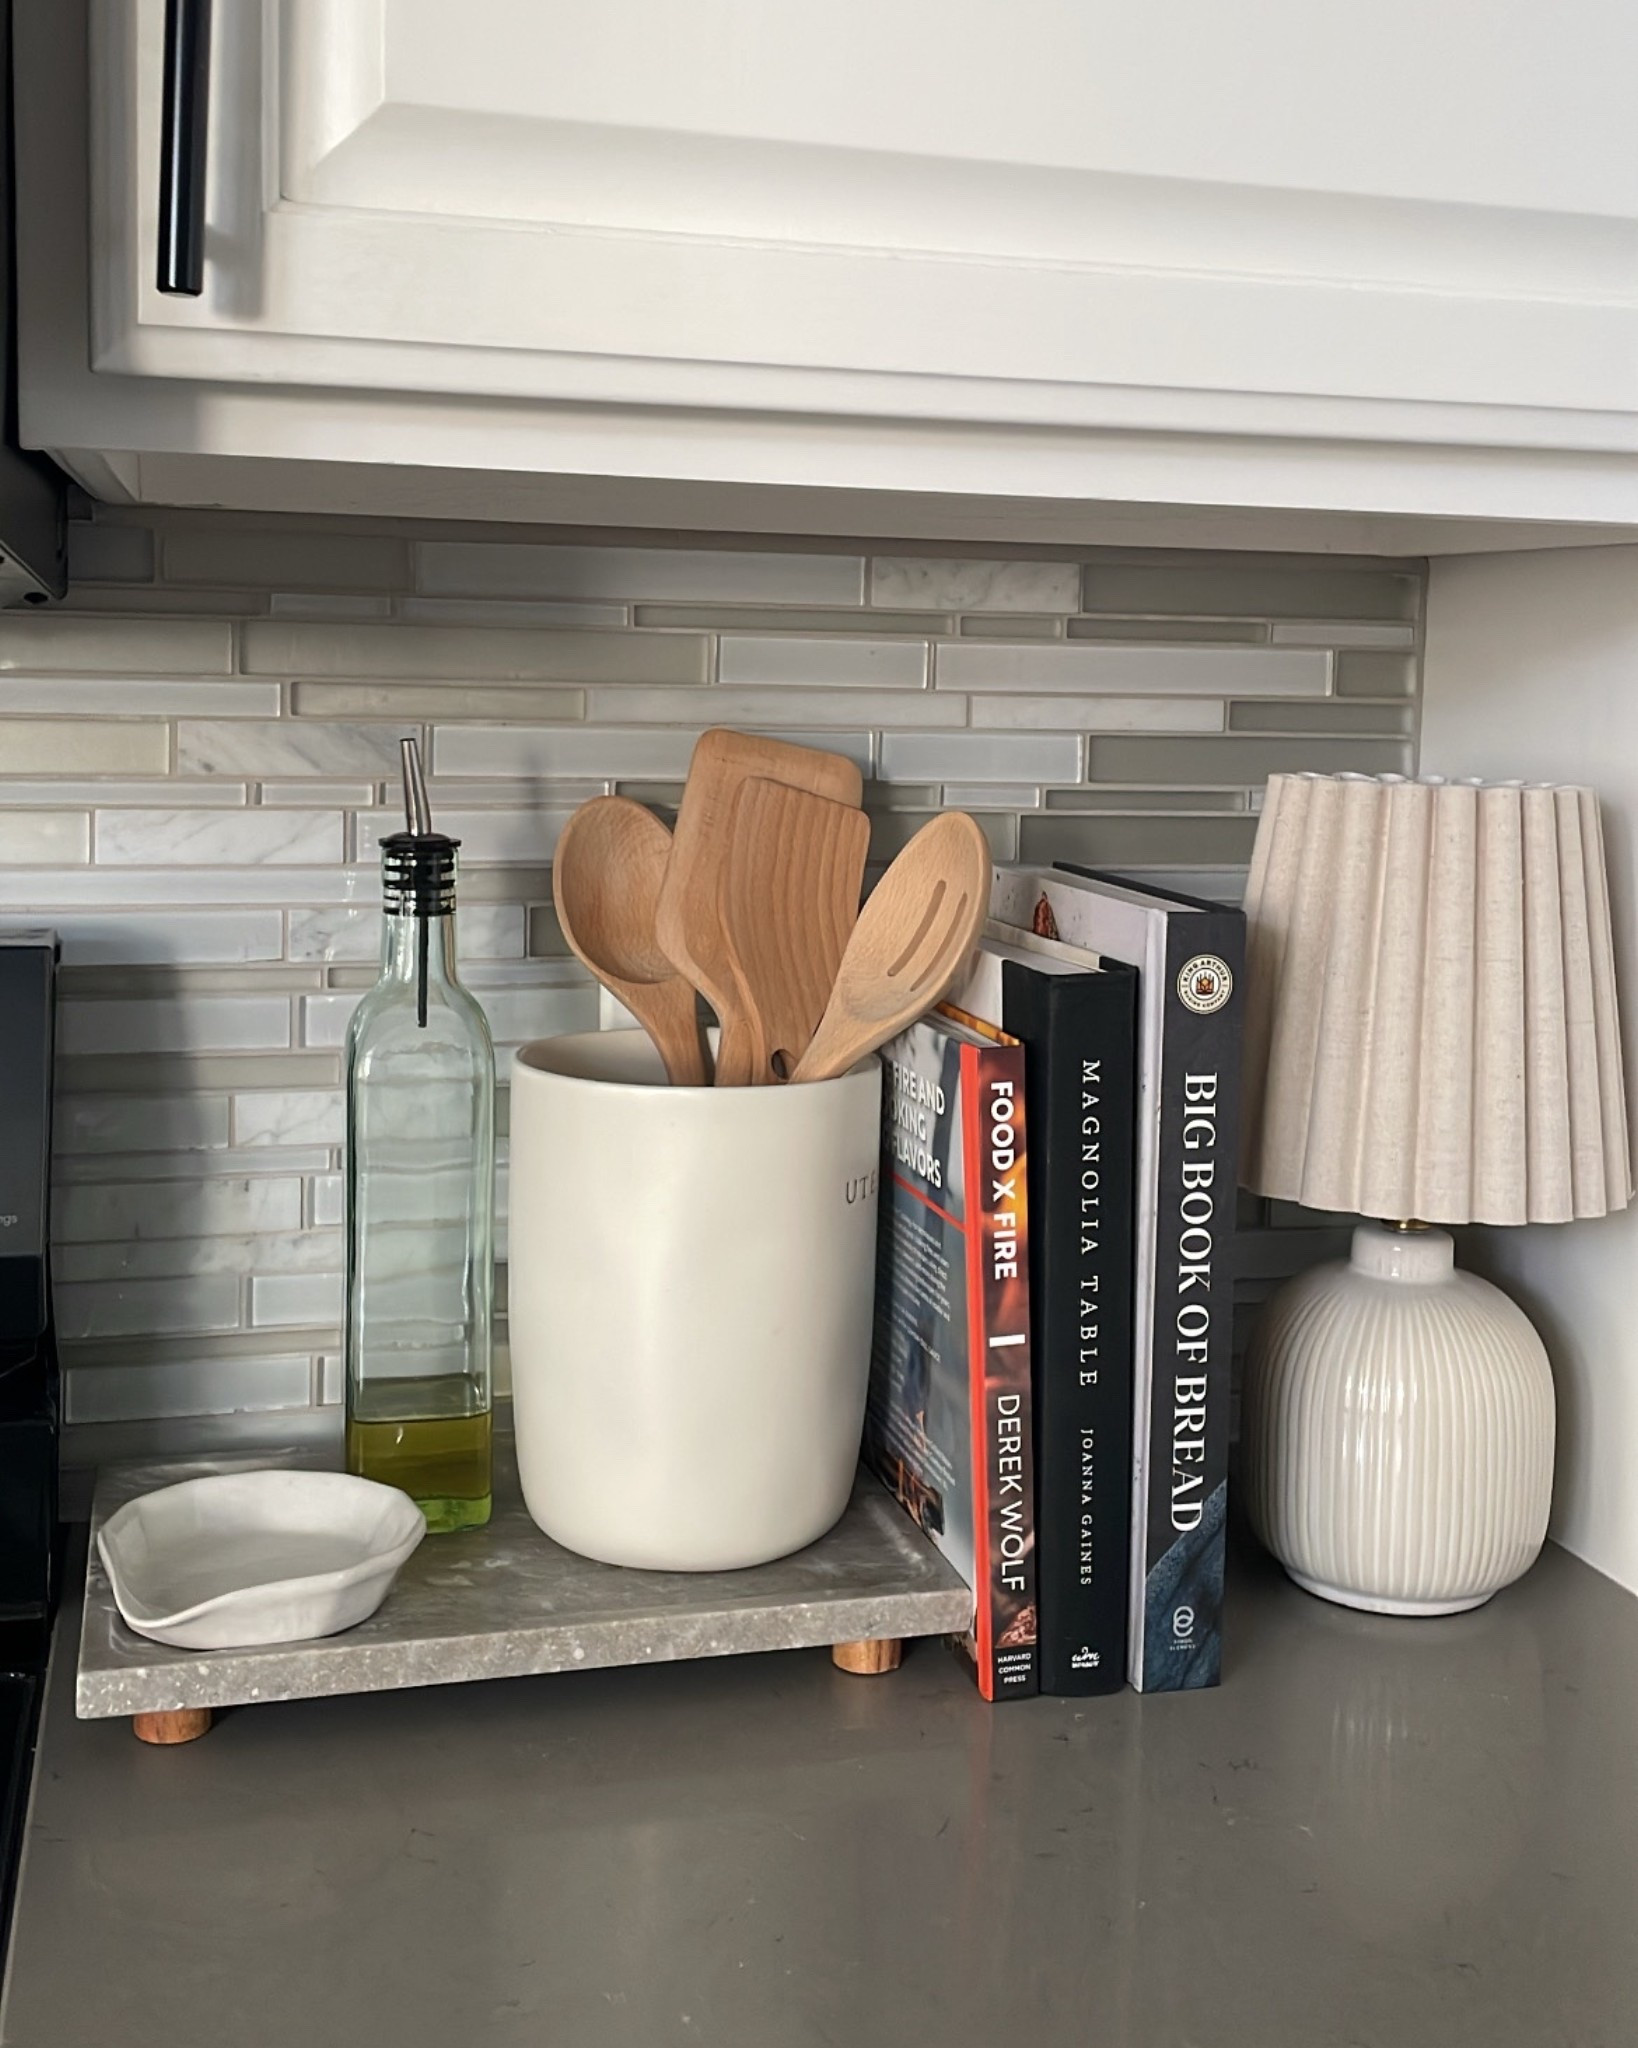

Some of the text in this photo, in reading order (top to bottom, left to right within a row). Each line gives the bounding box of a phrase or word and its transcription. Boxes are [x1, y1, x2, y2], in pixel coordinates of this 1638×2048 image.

[917, 1076, 946, 1116] AND
[990, 1081, 1014, 1171] FOOD
[993, 1212, 1017, 1280] FIRE
[1079, 1059, 1101, 1386] MAGNOLIA TABLE
[1170, 1072, 1218, 1532] BIG BOOK OF BREAD
[997, 1394, 1025, 1591] DEREK WOLF
[1079, 1429, 1094, 1585] JOANNA GAINES
[997, 1652, 1032, 1664] HARVARD
[998, 1663, 1031, 1674] COMMON
[1003, 1674, 1026, 1684] PRESS
